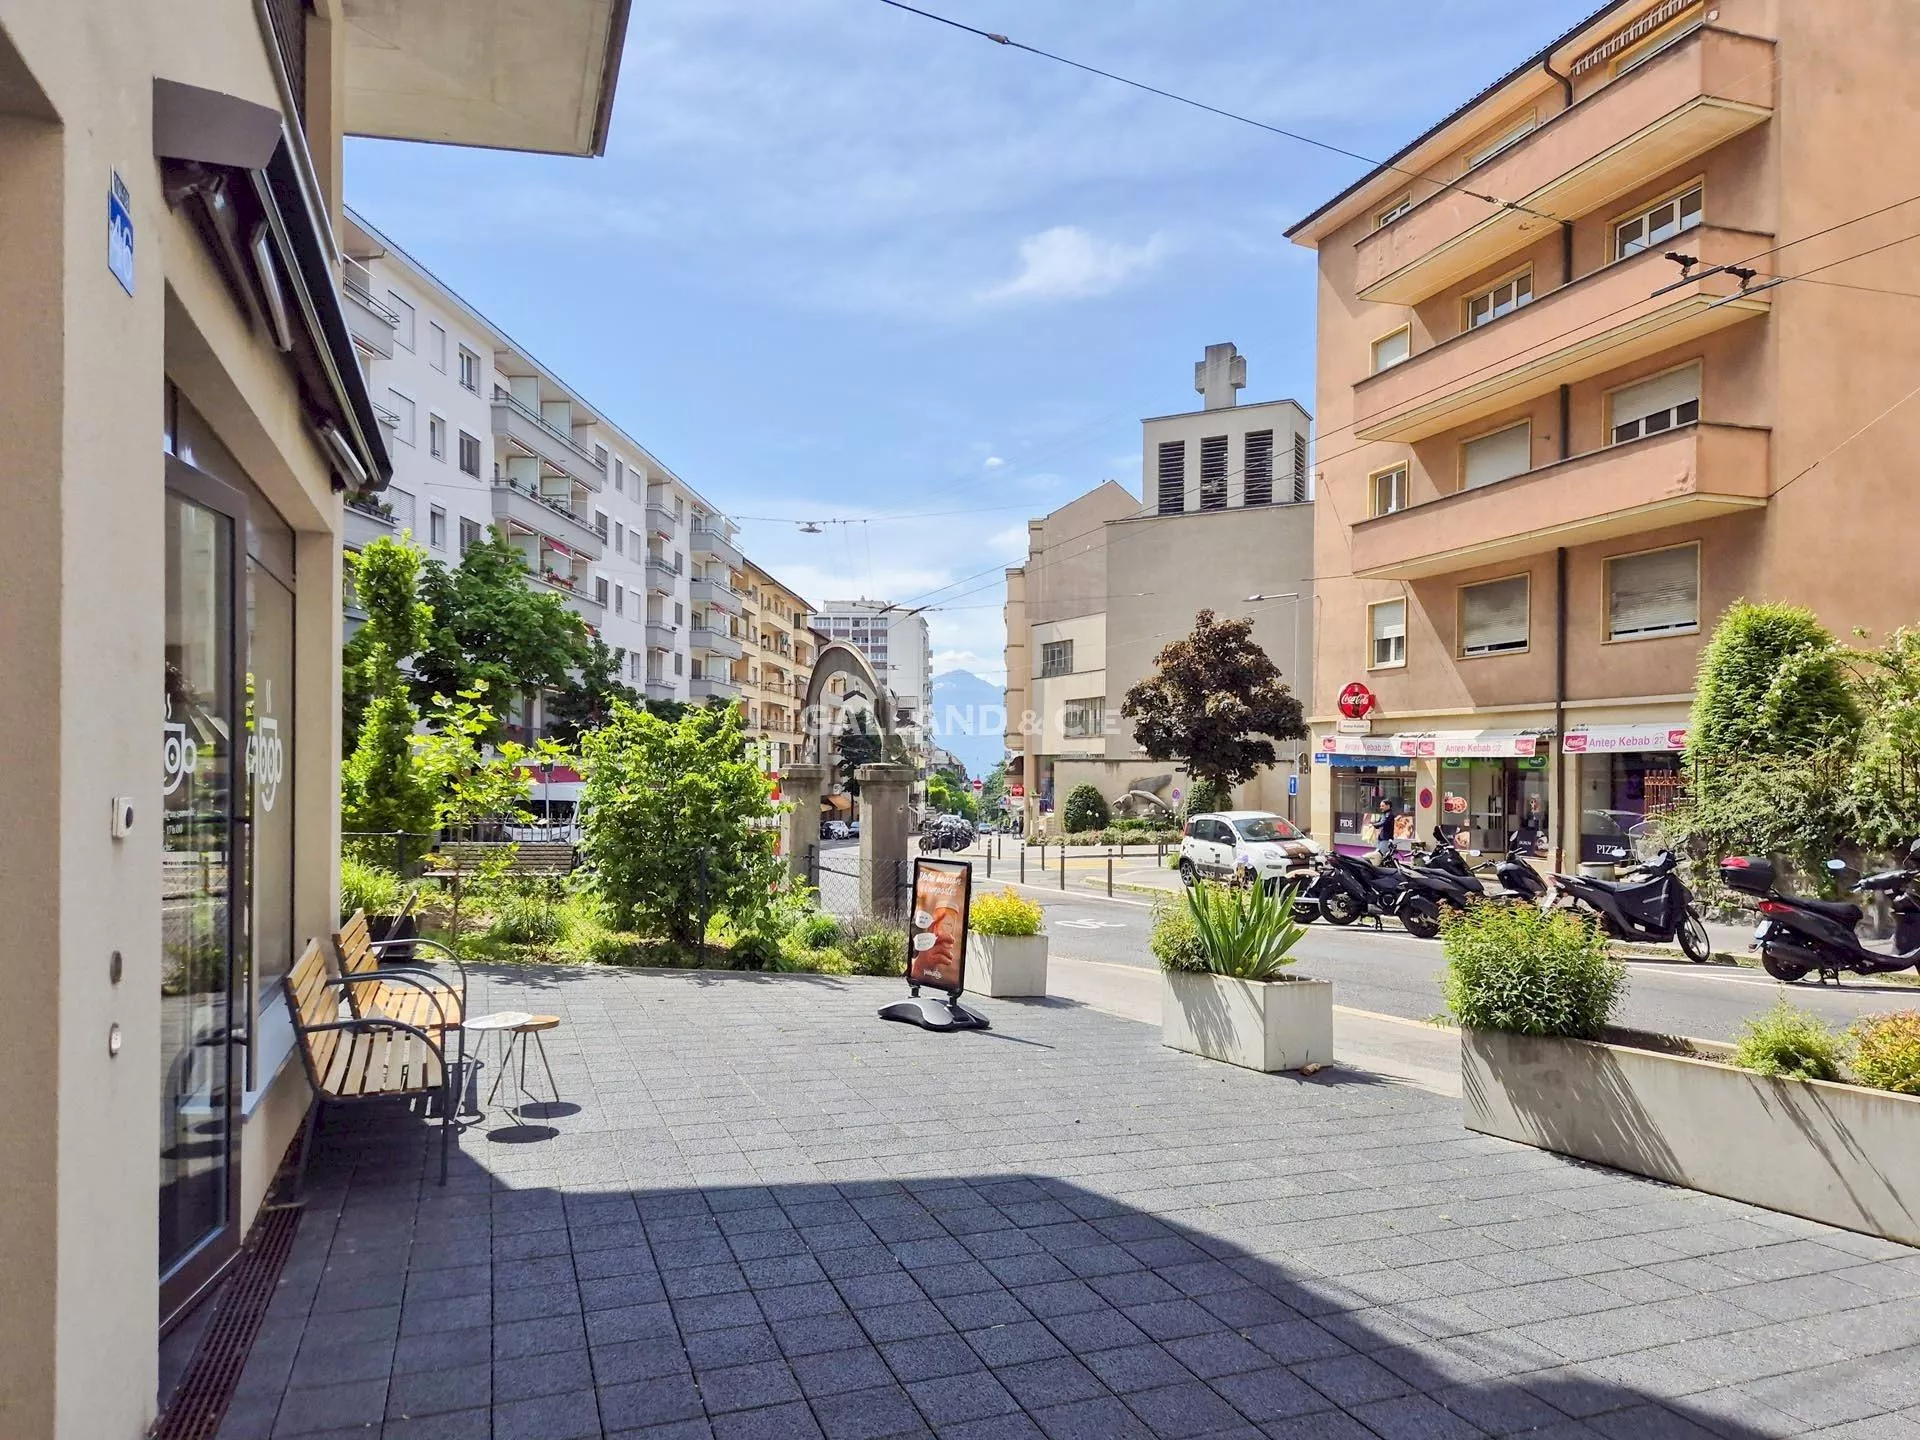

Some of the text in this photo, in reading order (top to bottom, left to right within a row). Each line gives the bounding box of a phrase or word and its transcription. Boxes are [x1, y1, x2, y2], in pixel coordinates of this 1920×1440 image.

[1589, 737, 1616, 749] Antep
[1618, 735, 1650, 747] Kebab
[1467, 743, 1491, 753] Kebab
[1339, 818, 1353, 828] PIDE
